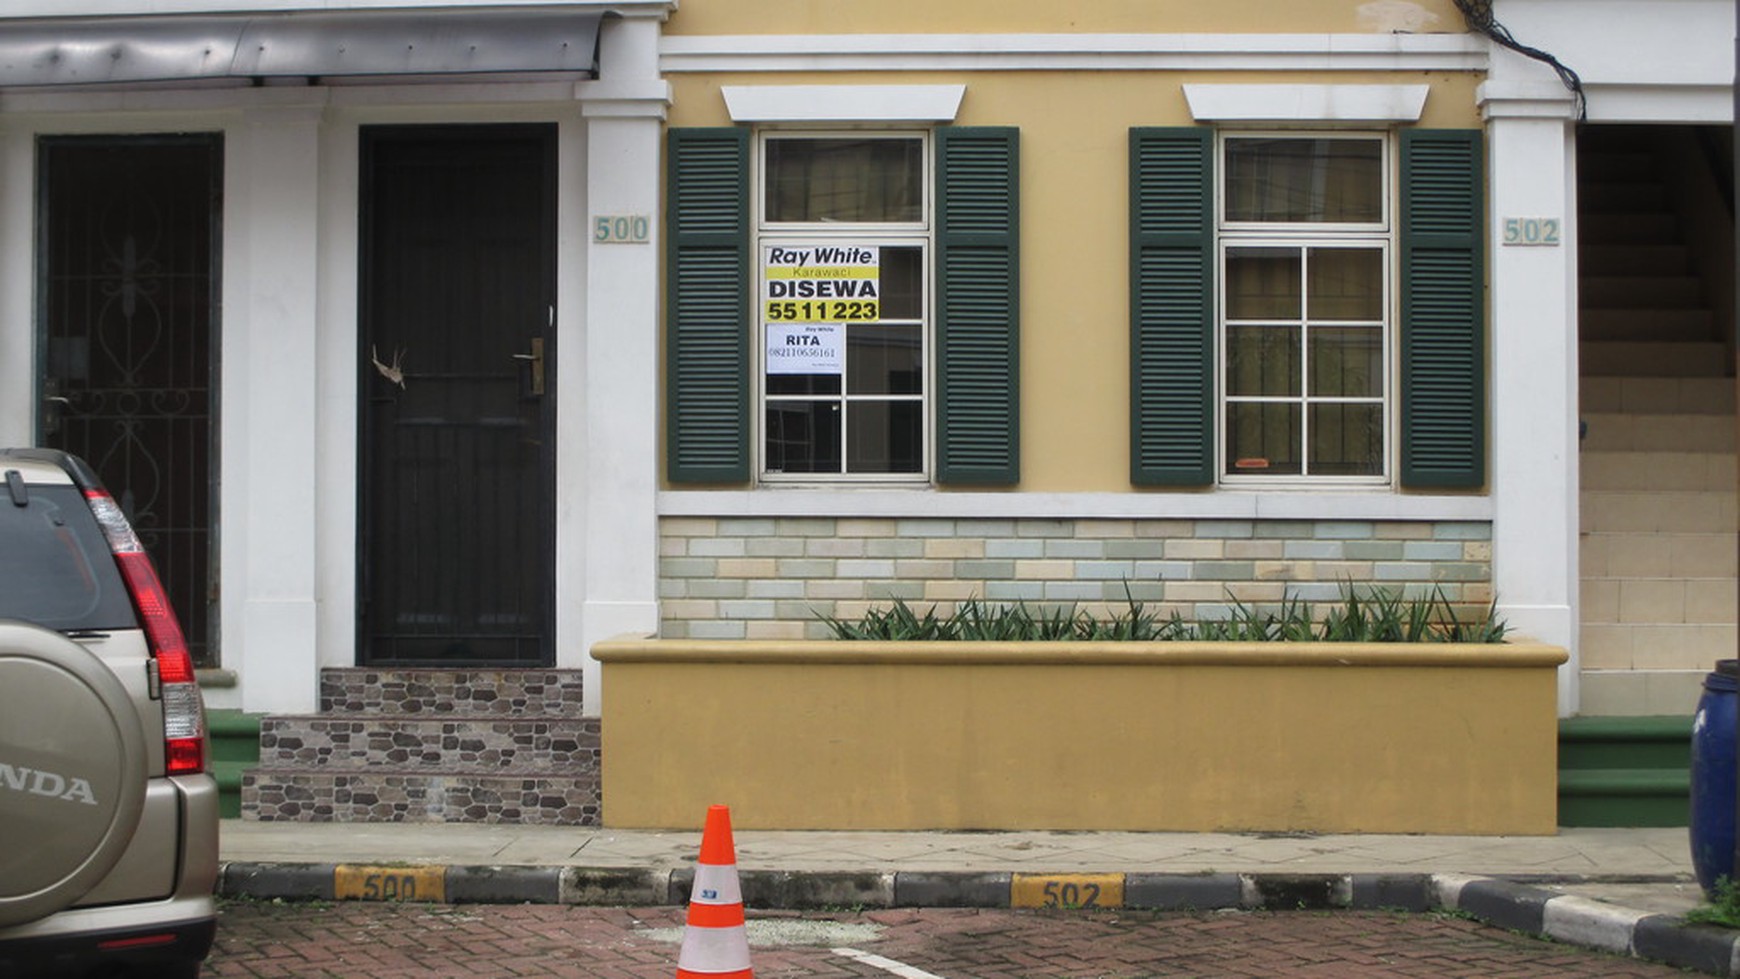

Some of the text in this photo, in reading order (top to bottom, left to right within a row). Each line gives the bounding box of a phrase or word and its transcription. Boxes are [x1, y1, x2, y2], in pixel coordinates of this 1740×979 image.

[596, 217, 647, 240] 500
[1504, 219, 1559, 241] 502
[769, 248, 873, 267] Ray White
[793, 268, 851, 277] Karawaci
[769, 281, 877, 298] DISEWA
[768, 302, 877, 320] 5511223
[786, 335, 820, 346] RITA
[364, 874, 416, 900] 500
[1043, 881, 1100, 909] 502
